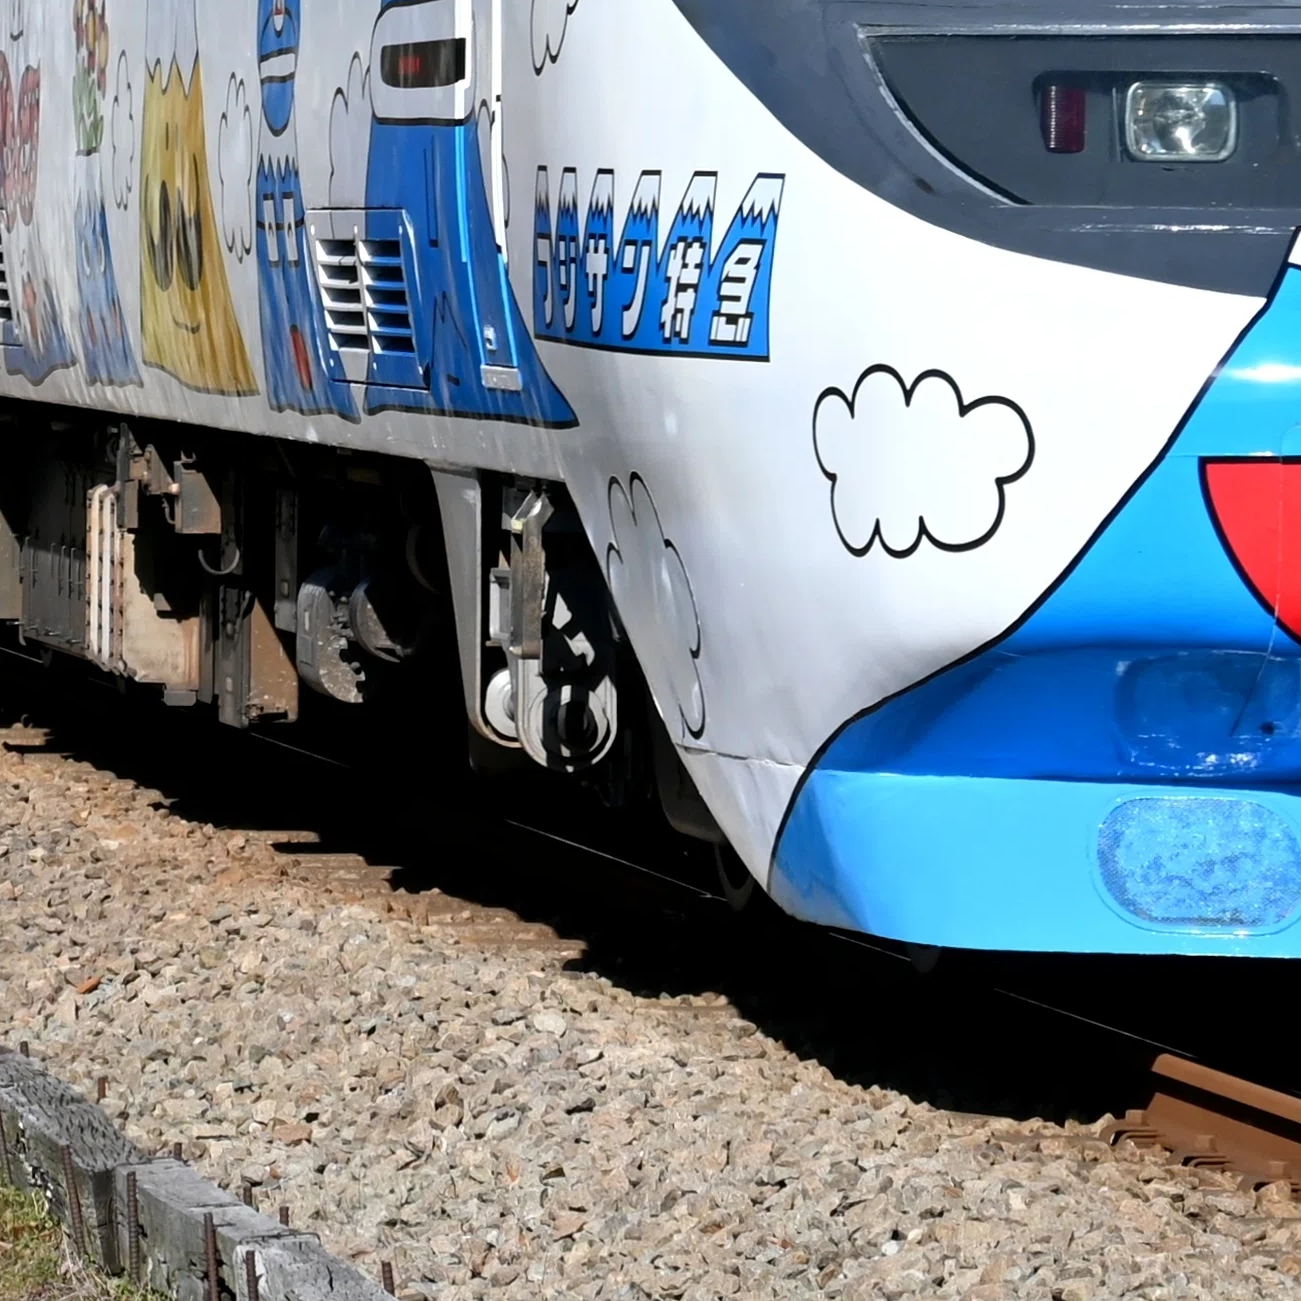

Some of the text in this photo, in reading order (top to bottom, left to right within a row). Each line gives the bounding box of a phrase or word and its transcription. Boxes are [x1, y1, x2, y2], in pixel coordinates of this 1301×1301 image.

[536, 231, 768, 347] フジサン特急
